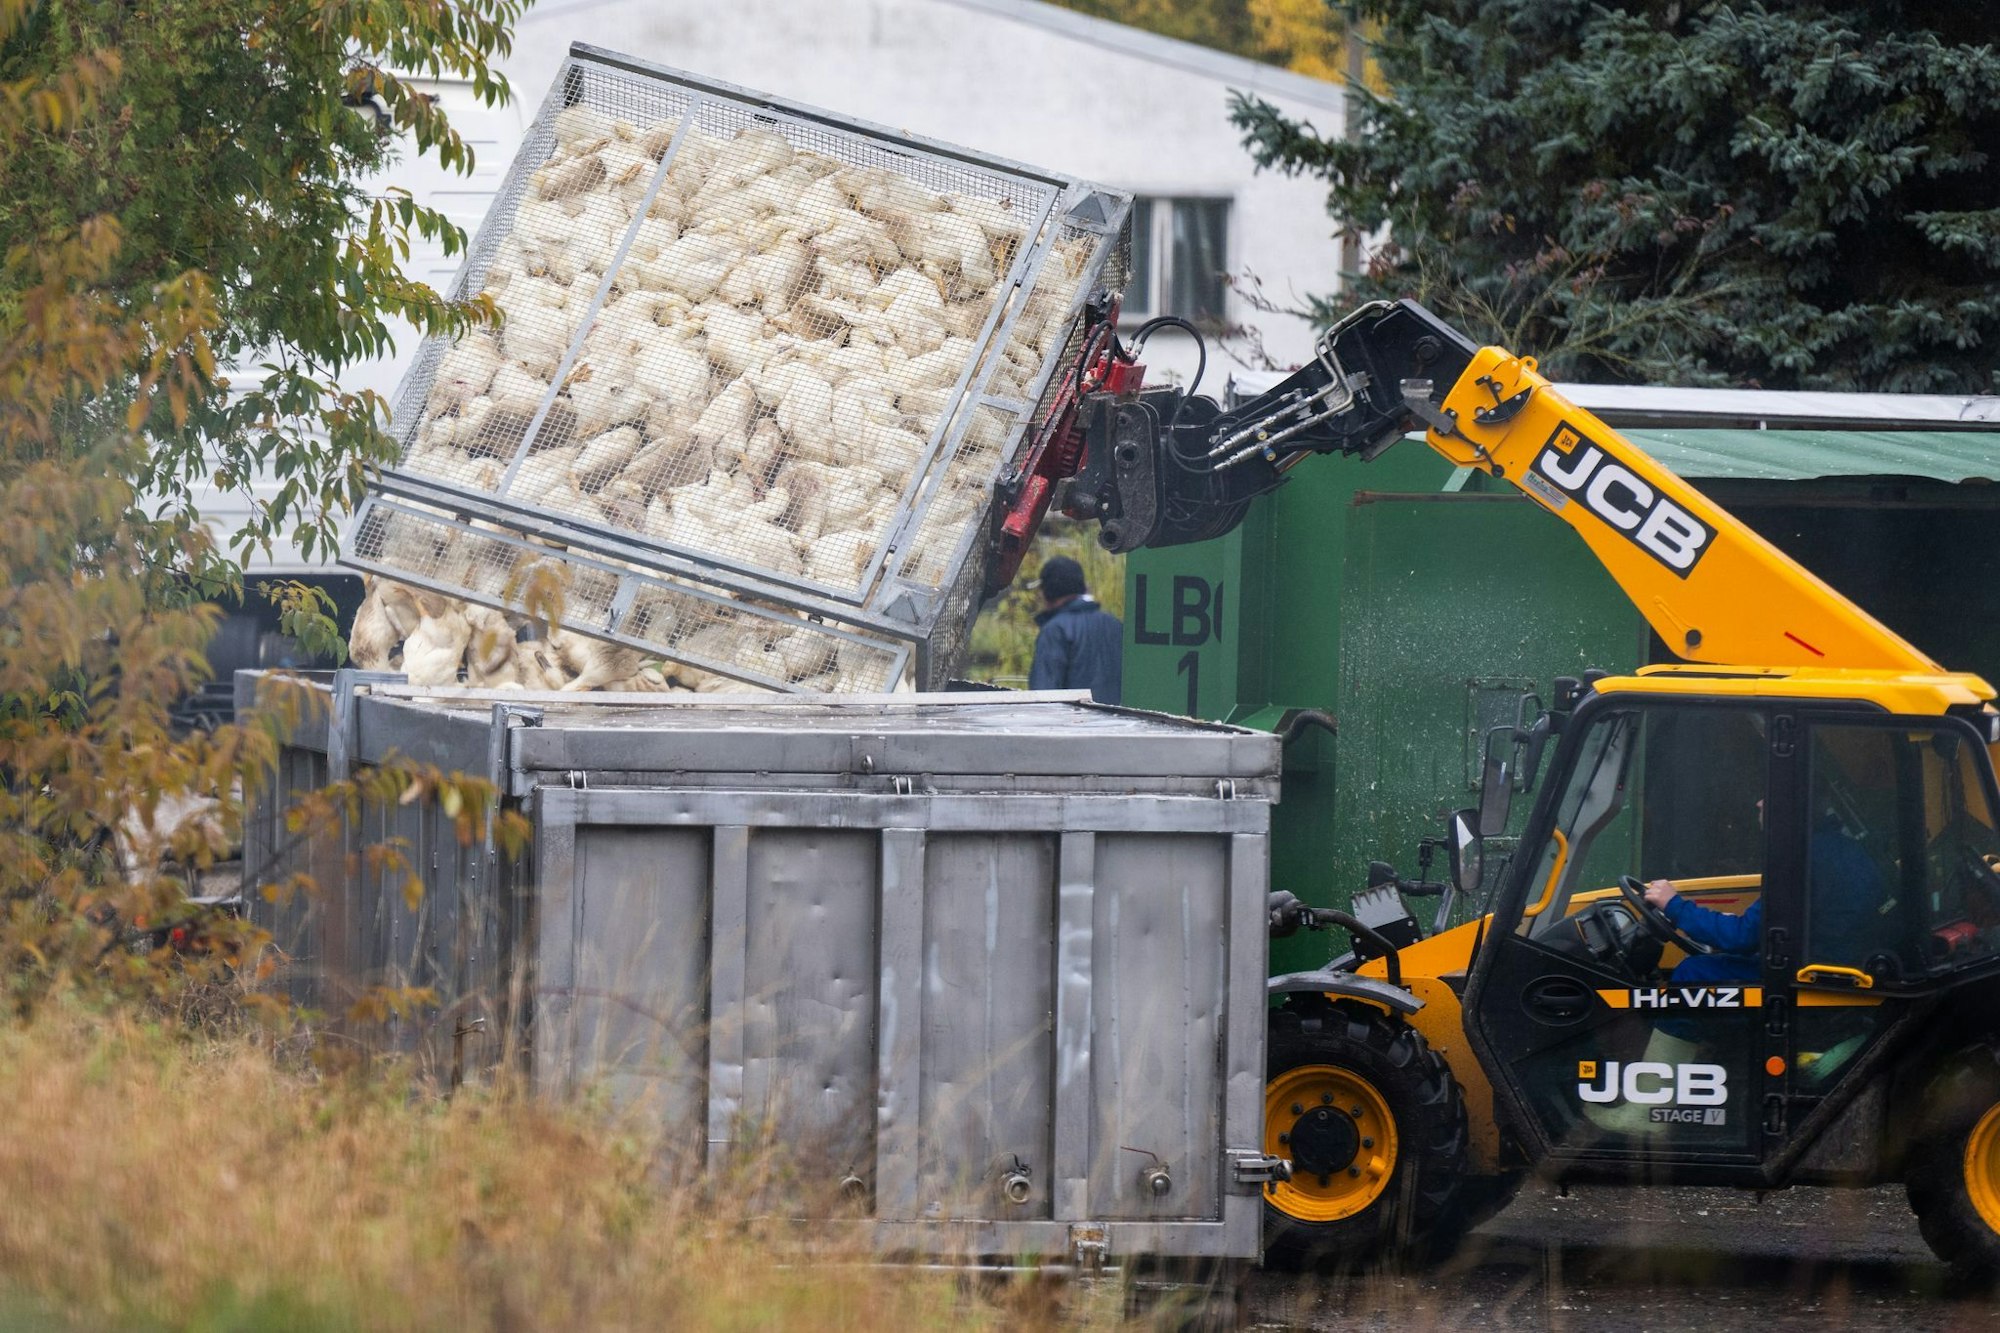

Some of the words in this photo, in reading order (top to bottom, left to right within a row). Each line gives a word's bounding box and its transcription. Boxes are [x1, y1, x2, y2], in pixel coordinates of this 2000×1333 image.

[1540, 446, 1707, 569] JCB
[1578, 1061, 1728, 1106] JCB
[1651, 1108, 1703, 1123] STAGE
